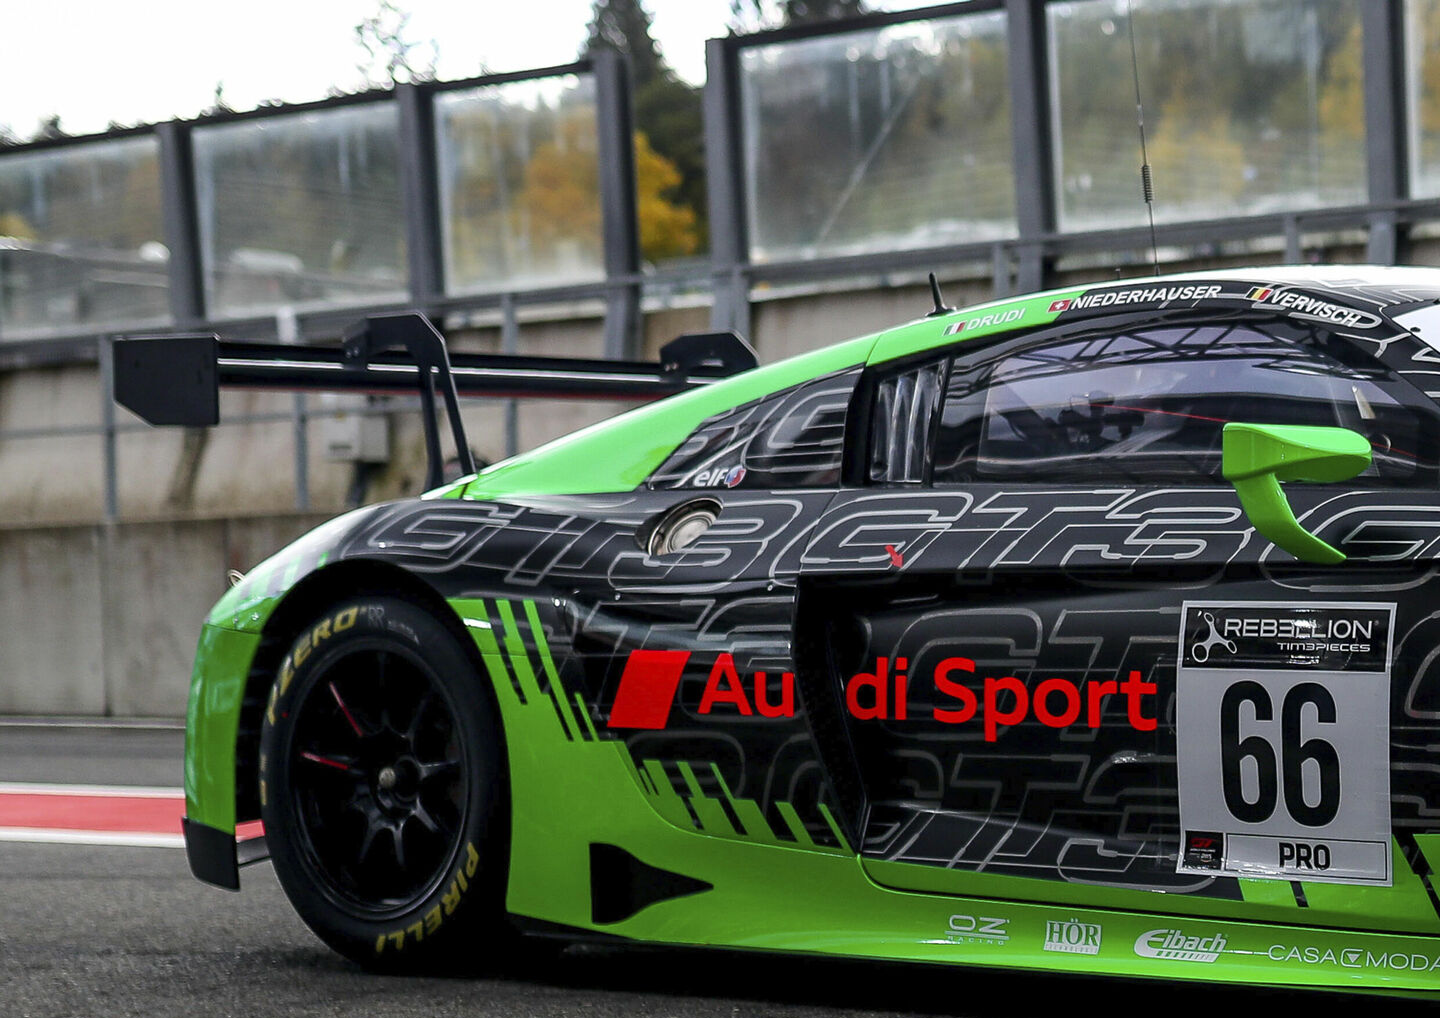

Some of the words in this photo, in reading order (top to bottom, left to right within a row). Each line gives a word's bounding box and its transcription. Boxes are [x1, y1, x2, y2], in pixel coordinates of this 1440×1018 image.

[1070, 284, 1222, 311] NIEDERHAUSER
[1270, 289, 1363, 328] VERVISCH
[966, 308, 1025, 331] DRUDI
[693, 468, 729, 487] elf
[1224, 618, 1373, 640] REBELLION
[932, 656, 1159, 743] Sport
[1220, 680, 1341, 828] 66
[1278, 841, 1332, 871] PRO
[375, 841, 479, 953] PIRELLI
[949, 914, 1006, 934] OZ
[1047, 917, 1100, 947] HÖR
[1134, 928, 1228, 963] Eibach
